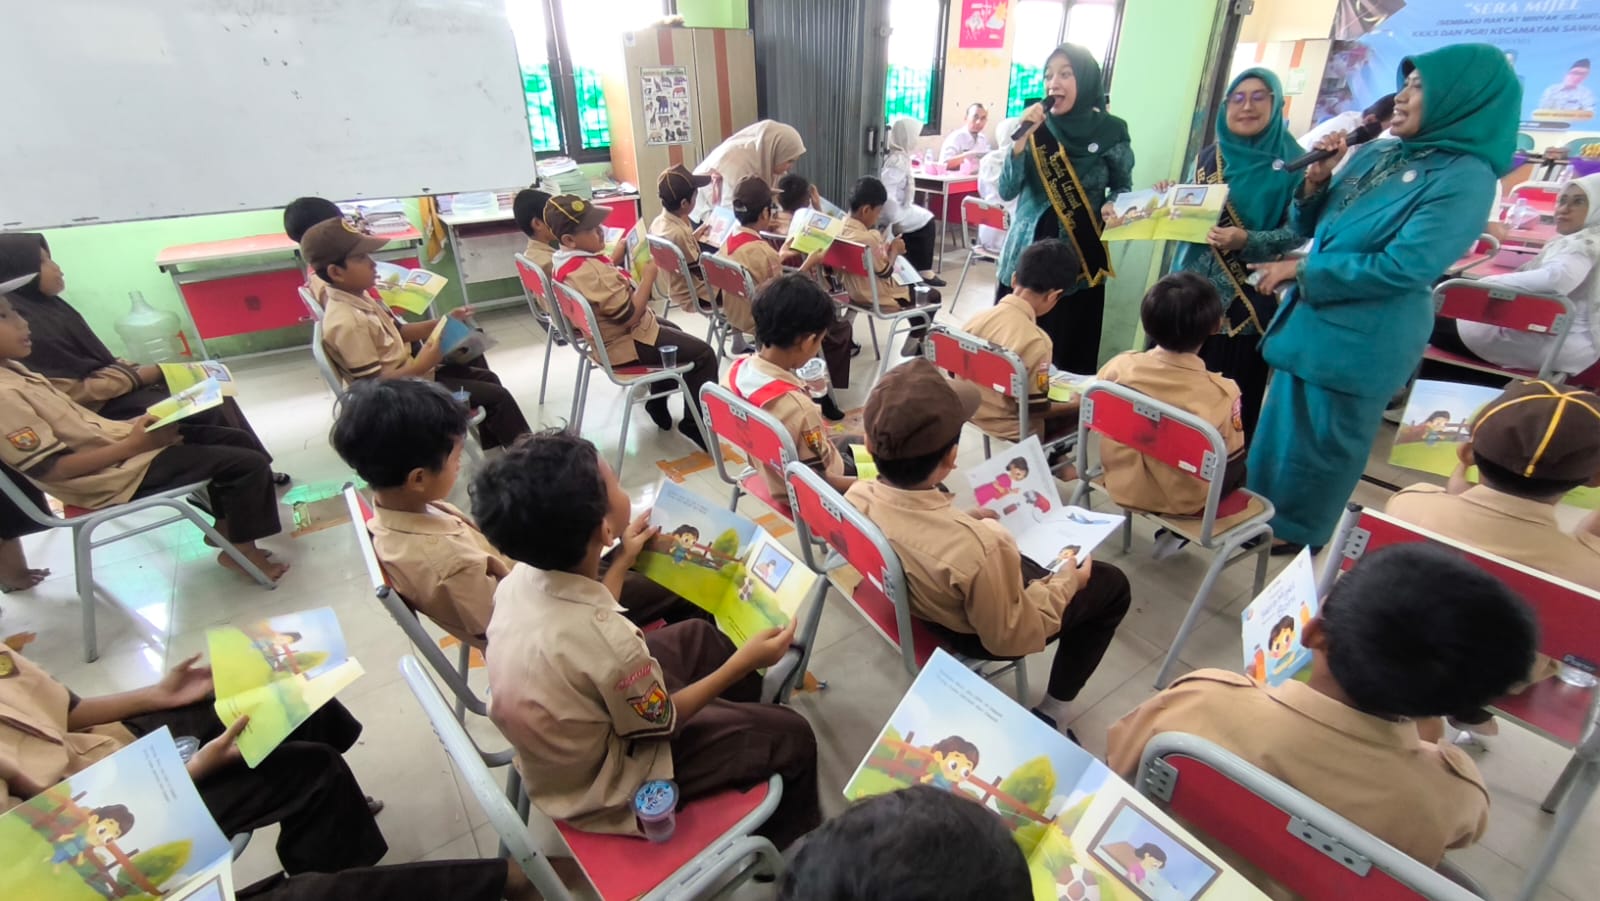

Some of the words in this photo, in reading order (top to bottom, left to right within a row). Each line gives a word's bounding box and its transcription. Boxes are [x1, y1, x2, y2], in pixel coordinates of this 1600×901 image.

[1483, 15, 1521, 24] RAKYAT
[1522, 13, 1557, 22] MINYAK
[1440, 28, 1461, 37] DAN
[1464, 26, 1488, 36] PGRI
[1489, 25, 1559, 36] KECAMATAN
